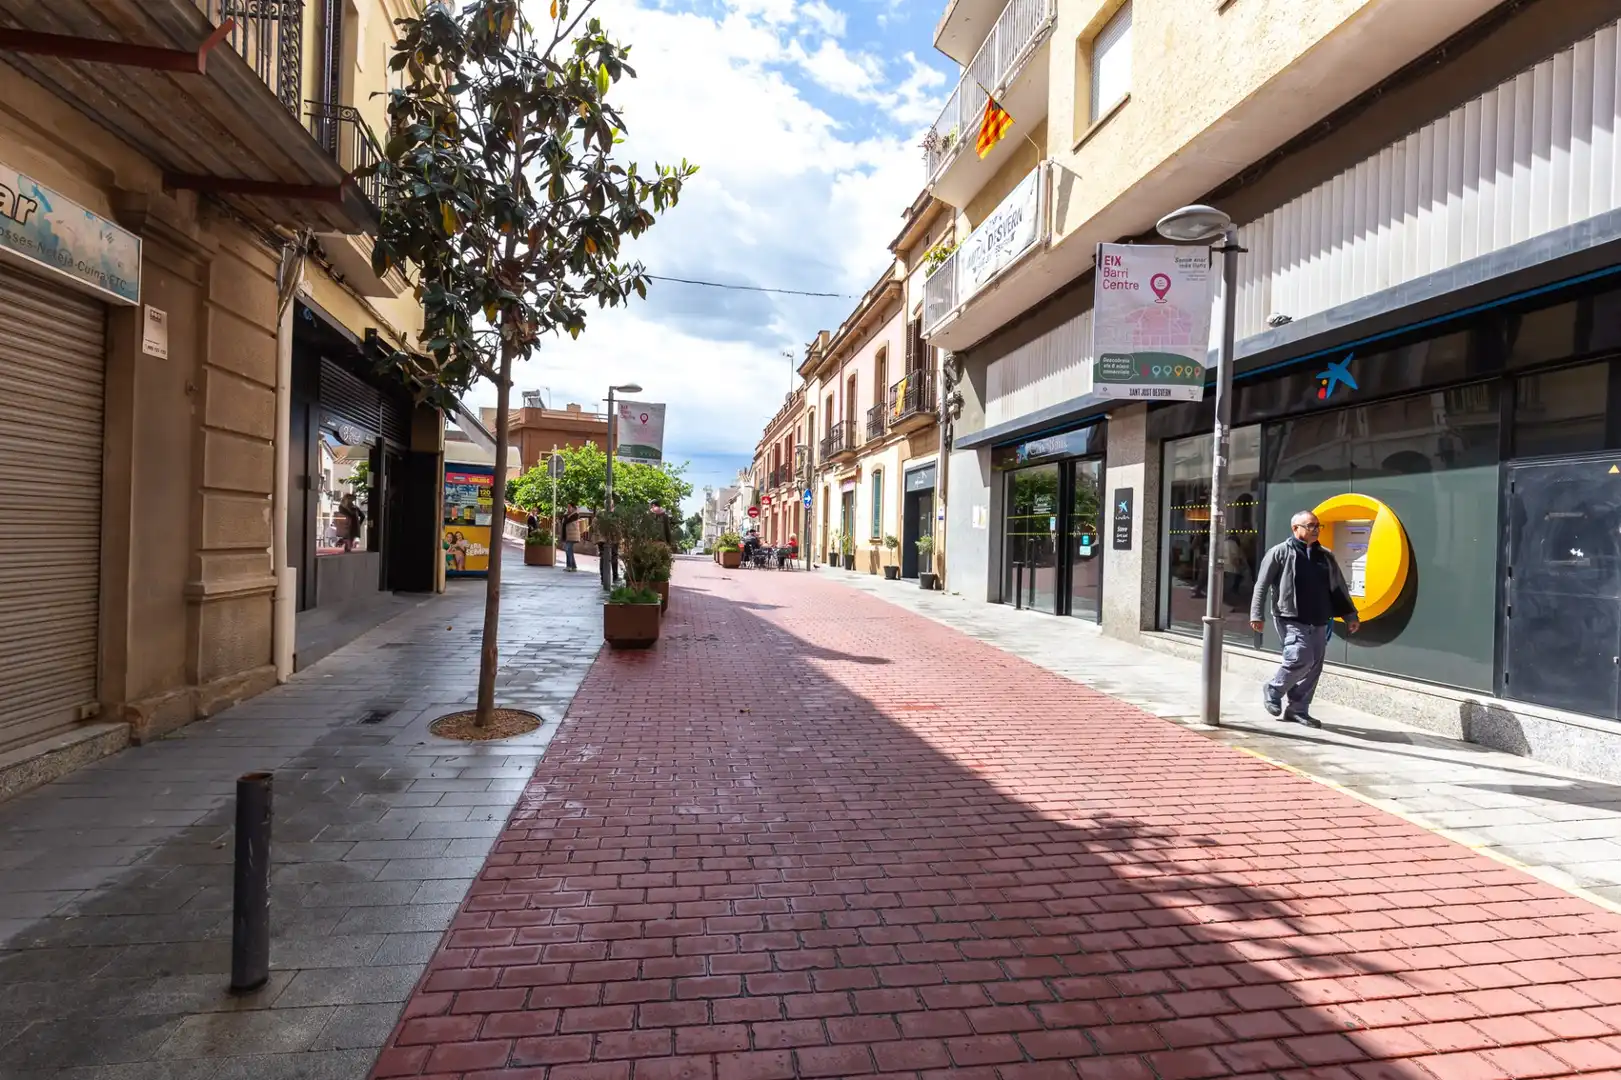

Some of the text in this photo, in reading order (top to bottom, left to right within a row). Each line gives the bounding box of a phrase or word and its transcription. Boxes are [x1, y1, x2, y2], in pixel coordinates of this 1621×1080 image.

[1104, 255, 1122, 266] EIX
[1103, 267, 1129, 278] Barri
[1102, 279, 1140, 291] Centre
